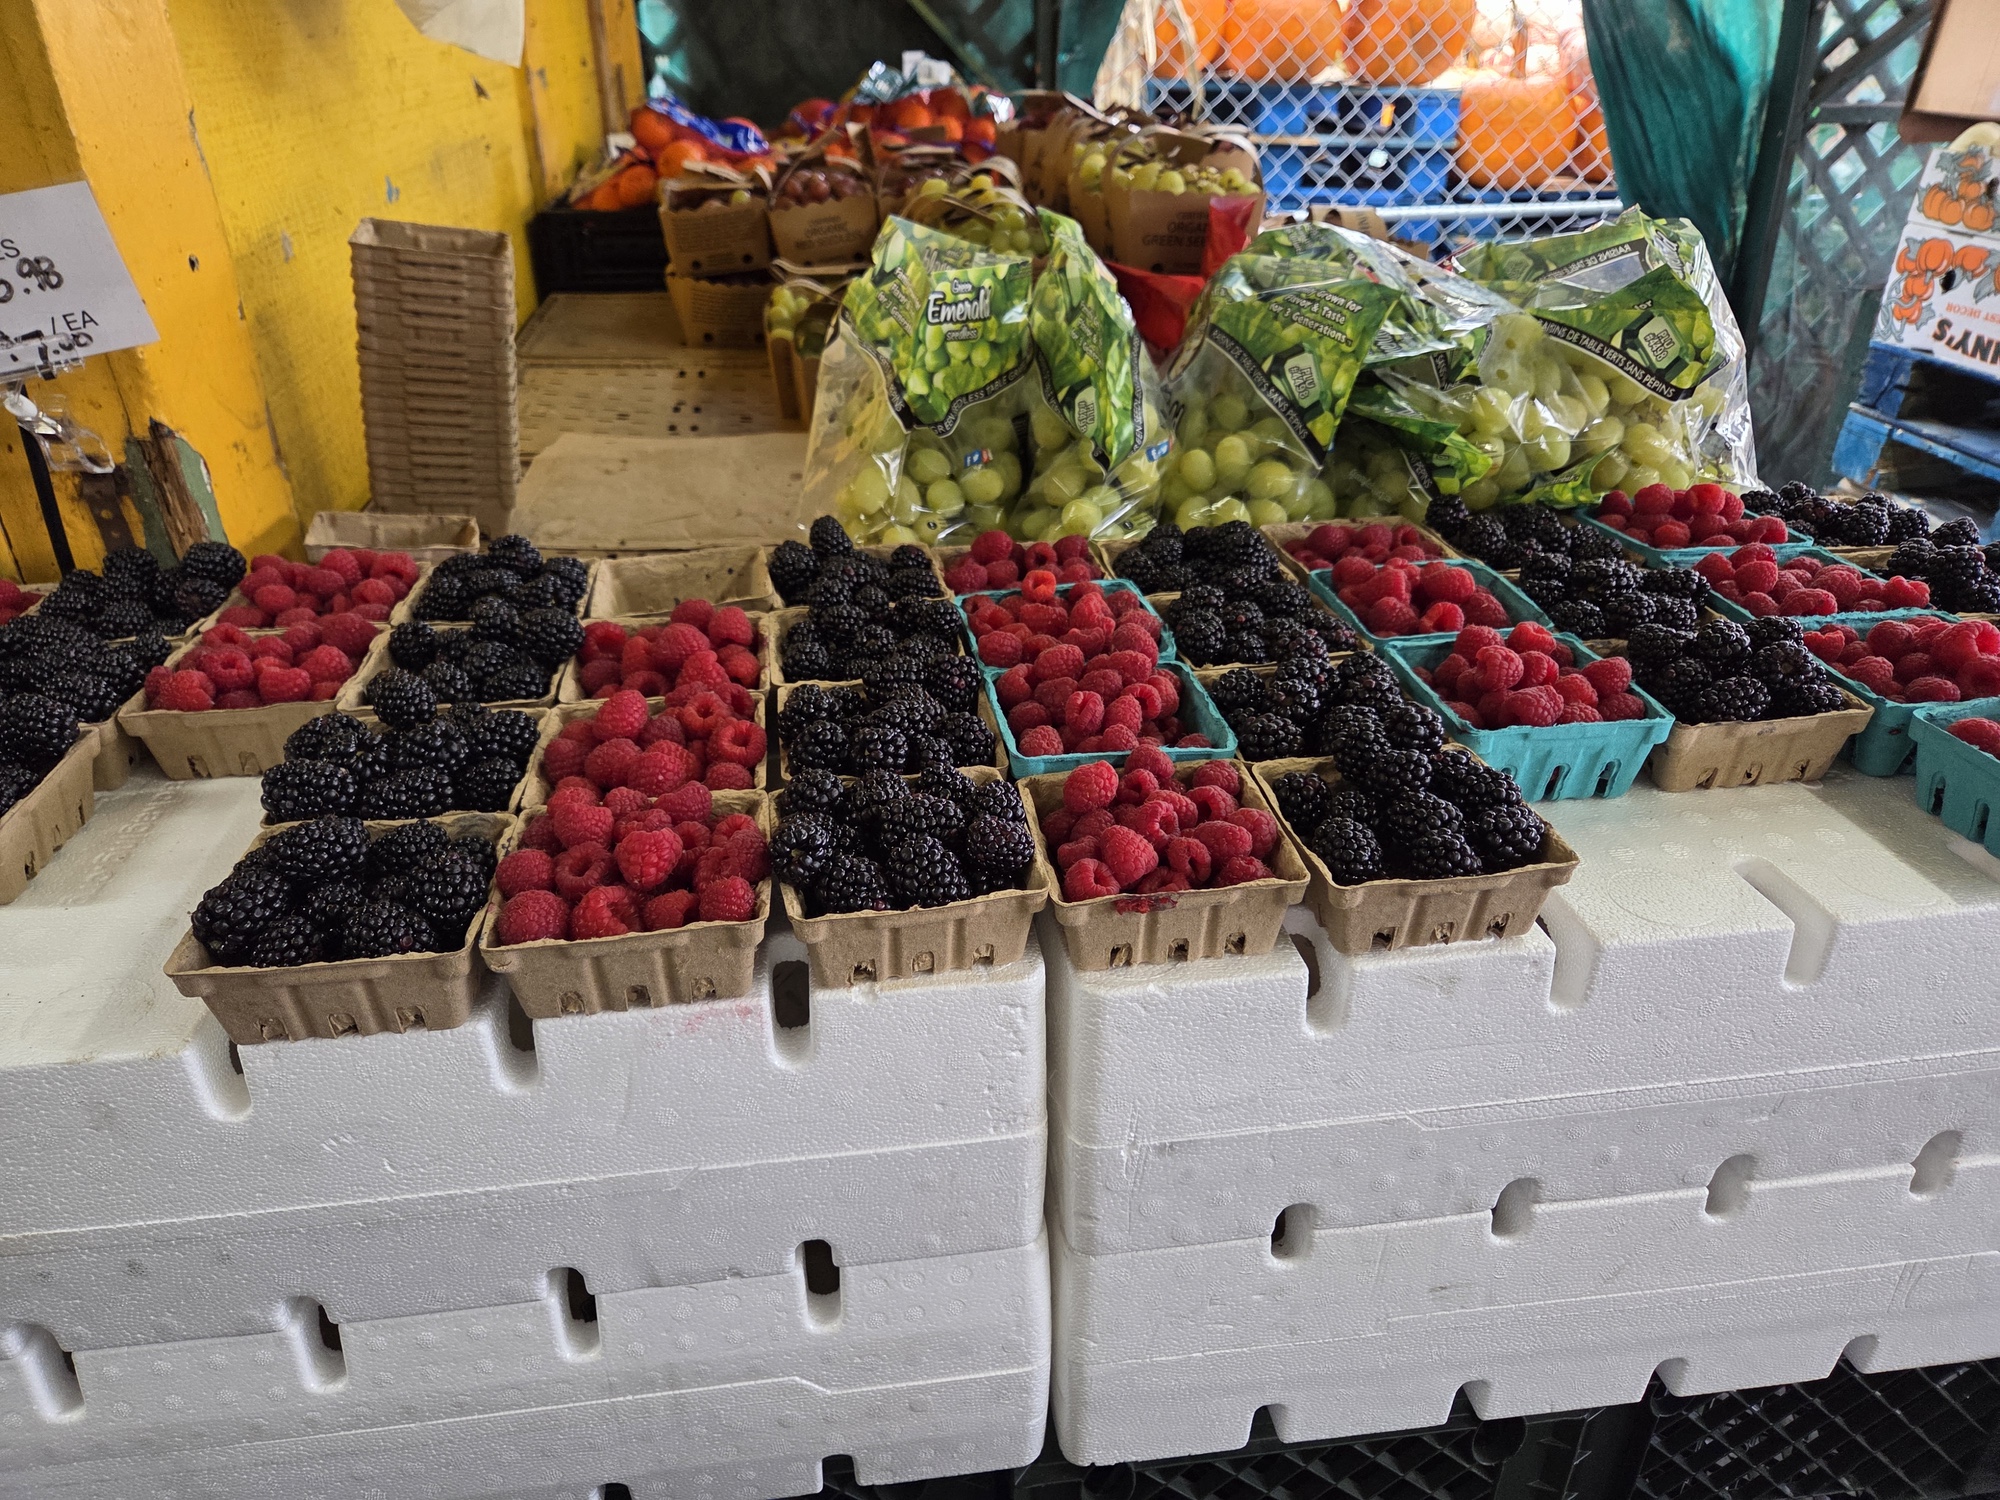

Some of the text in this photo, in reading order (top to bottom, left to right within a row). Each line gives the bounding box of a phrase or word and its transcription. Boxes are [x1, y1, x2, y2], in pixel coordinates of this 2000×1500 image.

[0, 238, 20, 260] S
[951, 277, 974, 294] Green
[926, 284, 993, 325] Emerald
[1269, 302, 1283, 314] for
[1283, 307, 1292, 317] 3
[1316, 290, 1346, 307] Grown
[1344, 299, 1364, 313] for
[1633, 299, 1653, 311] for
[1311, 303, 1320, 314] &
[1321, 306, 1347, 325] Taste
[946, 326, 979, 341] seedless
[1657, 329, 1674, 350] PLU
[1644, 332, 1668, 362] #4498
[1567, 330, 1580, 344] DE
[1580, 336, 1604, 355] TABLE
[1602, 346, 1625, 367] VERTS
[1623, 361, 1646, 382] SANS
[1643, 374, 1676, 399] PÉPINS
[986, 375, 1008, 394] TABLE
[1289, 366, 1309, 399] #4498
[1300, 366, 1316, 389] PLU
[1267, 388, 1290, 412] SANS
